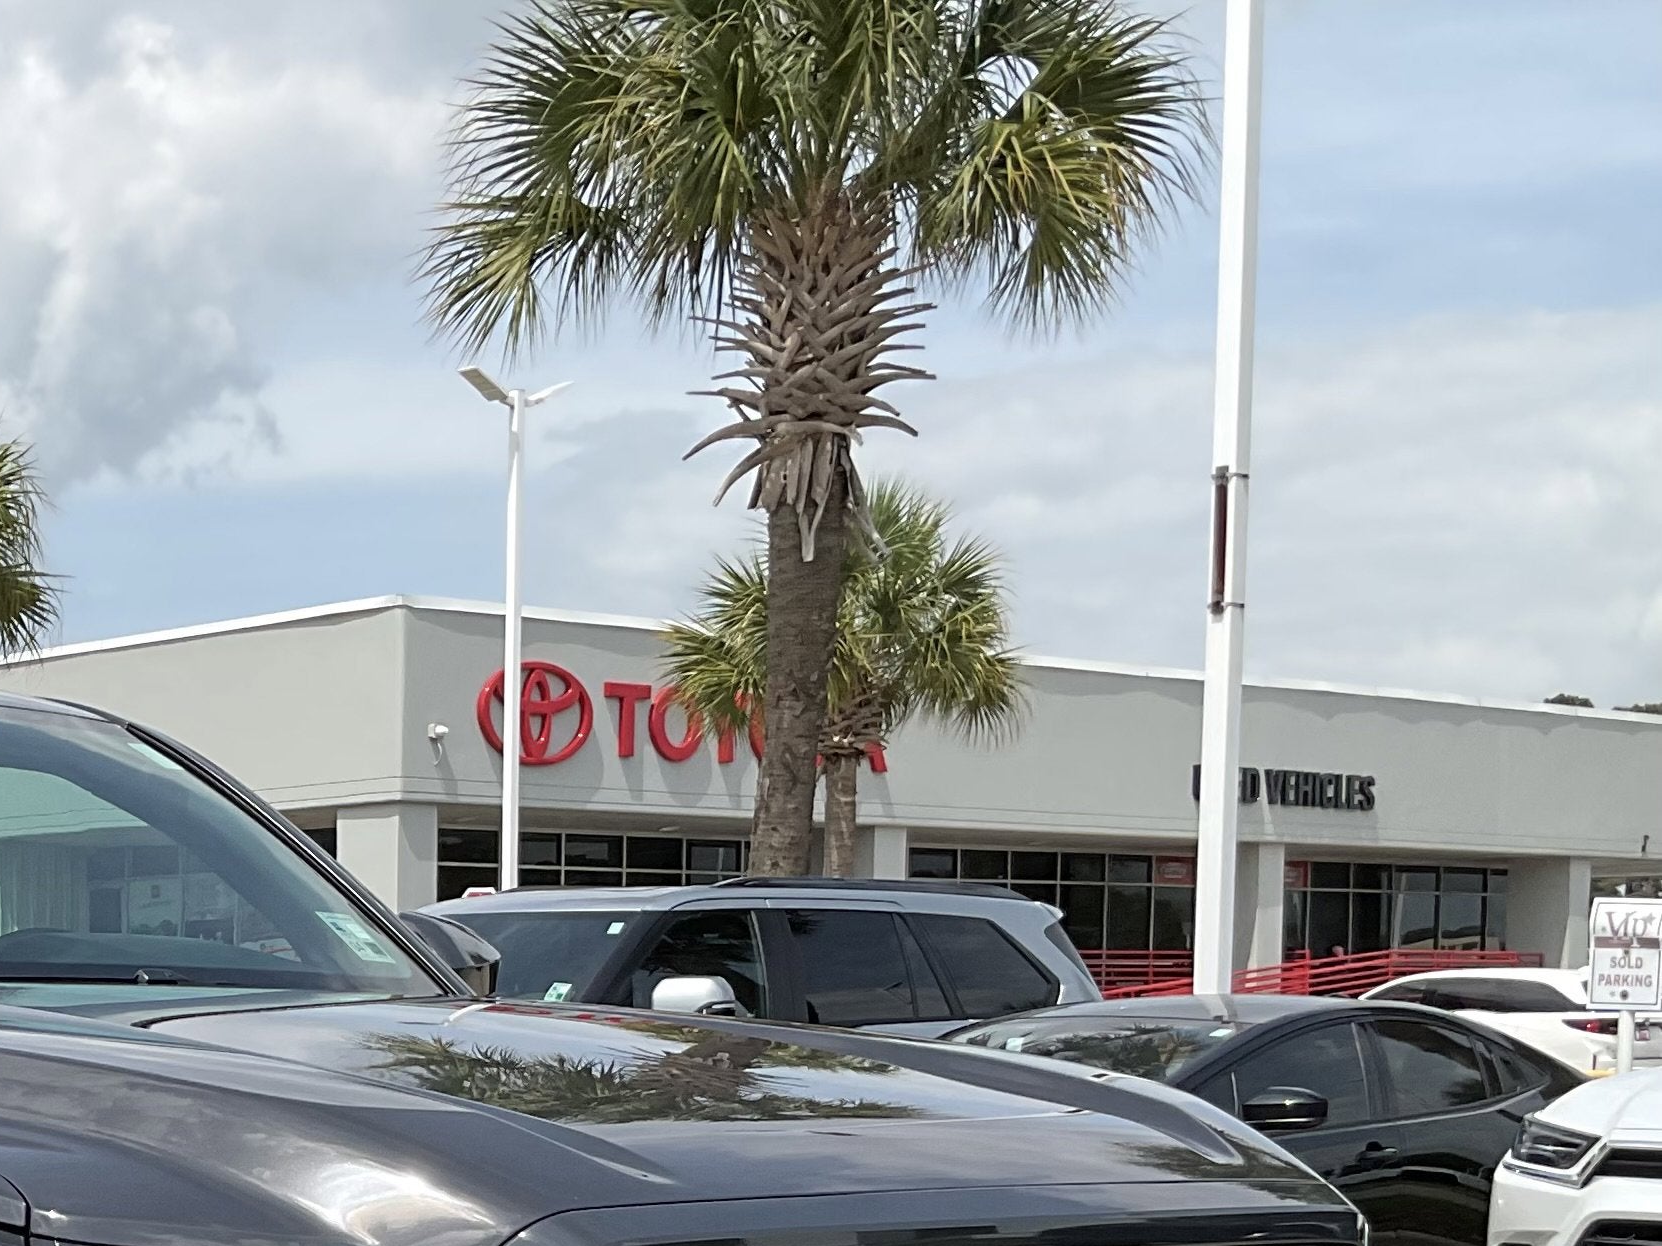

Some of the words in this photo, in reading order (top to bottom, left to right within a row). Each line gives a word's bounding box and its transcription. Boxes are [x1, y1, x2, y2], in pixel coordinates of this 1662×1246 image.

[1264, 769, 1375, 811] VEHICLES
[1610, 957, 1643, 969] SOLD
[1598, 974, 1653, 988] PARKING
